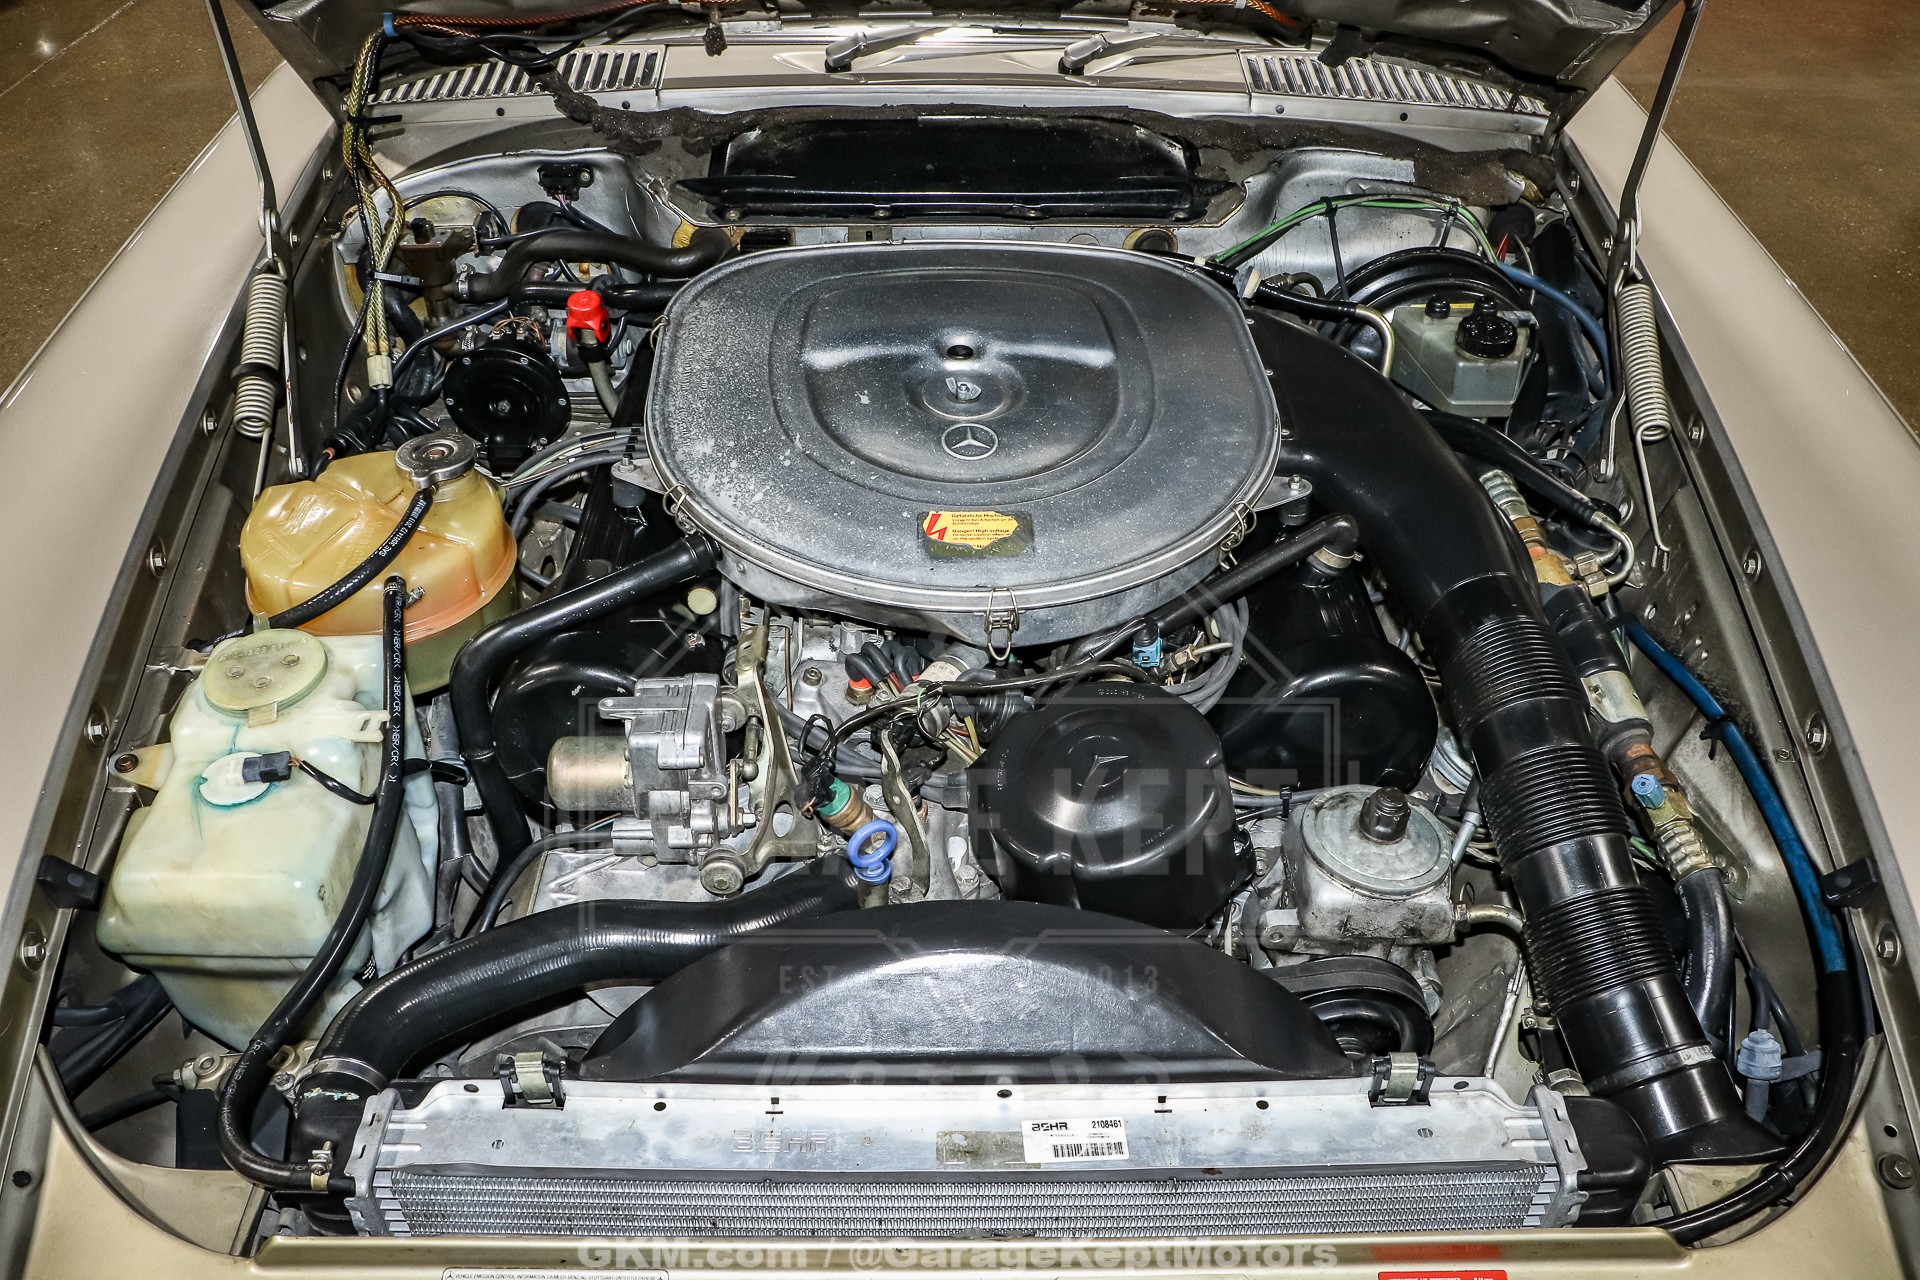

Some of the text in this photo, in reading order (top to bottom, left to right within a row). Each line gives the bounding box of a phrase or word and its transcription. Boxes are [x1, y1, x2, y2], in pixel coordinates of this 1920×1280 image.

[378, 545, 392, 557] SAE
[1031, 1121, 1068, 1132] BEHR
[1091, 1119, 1122, 1129] 2108461
